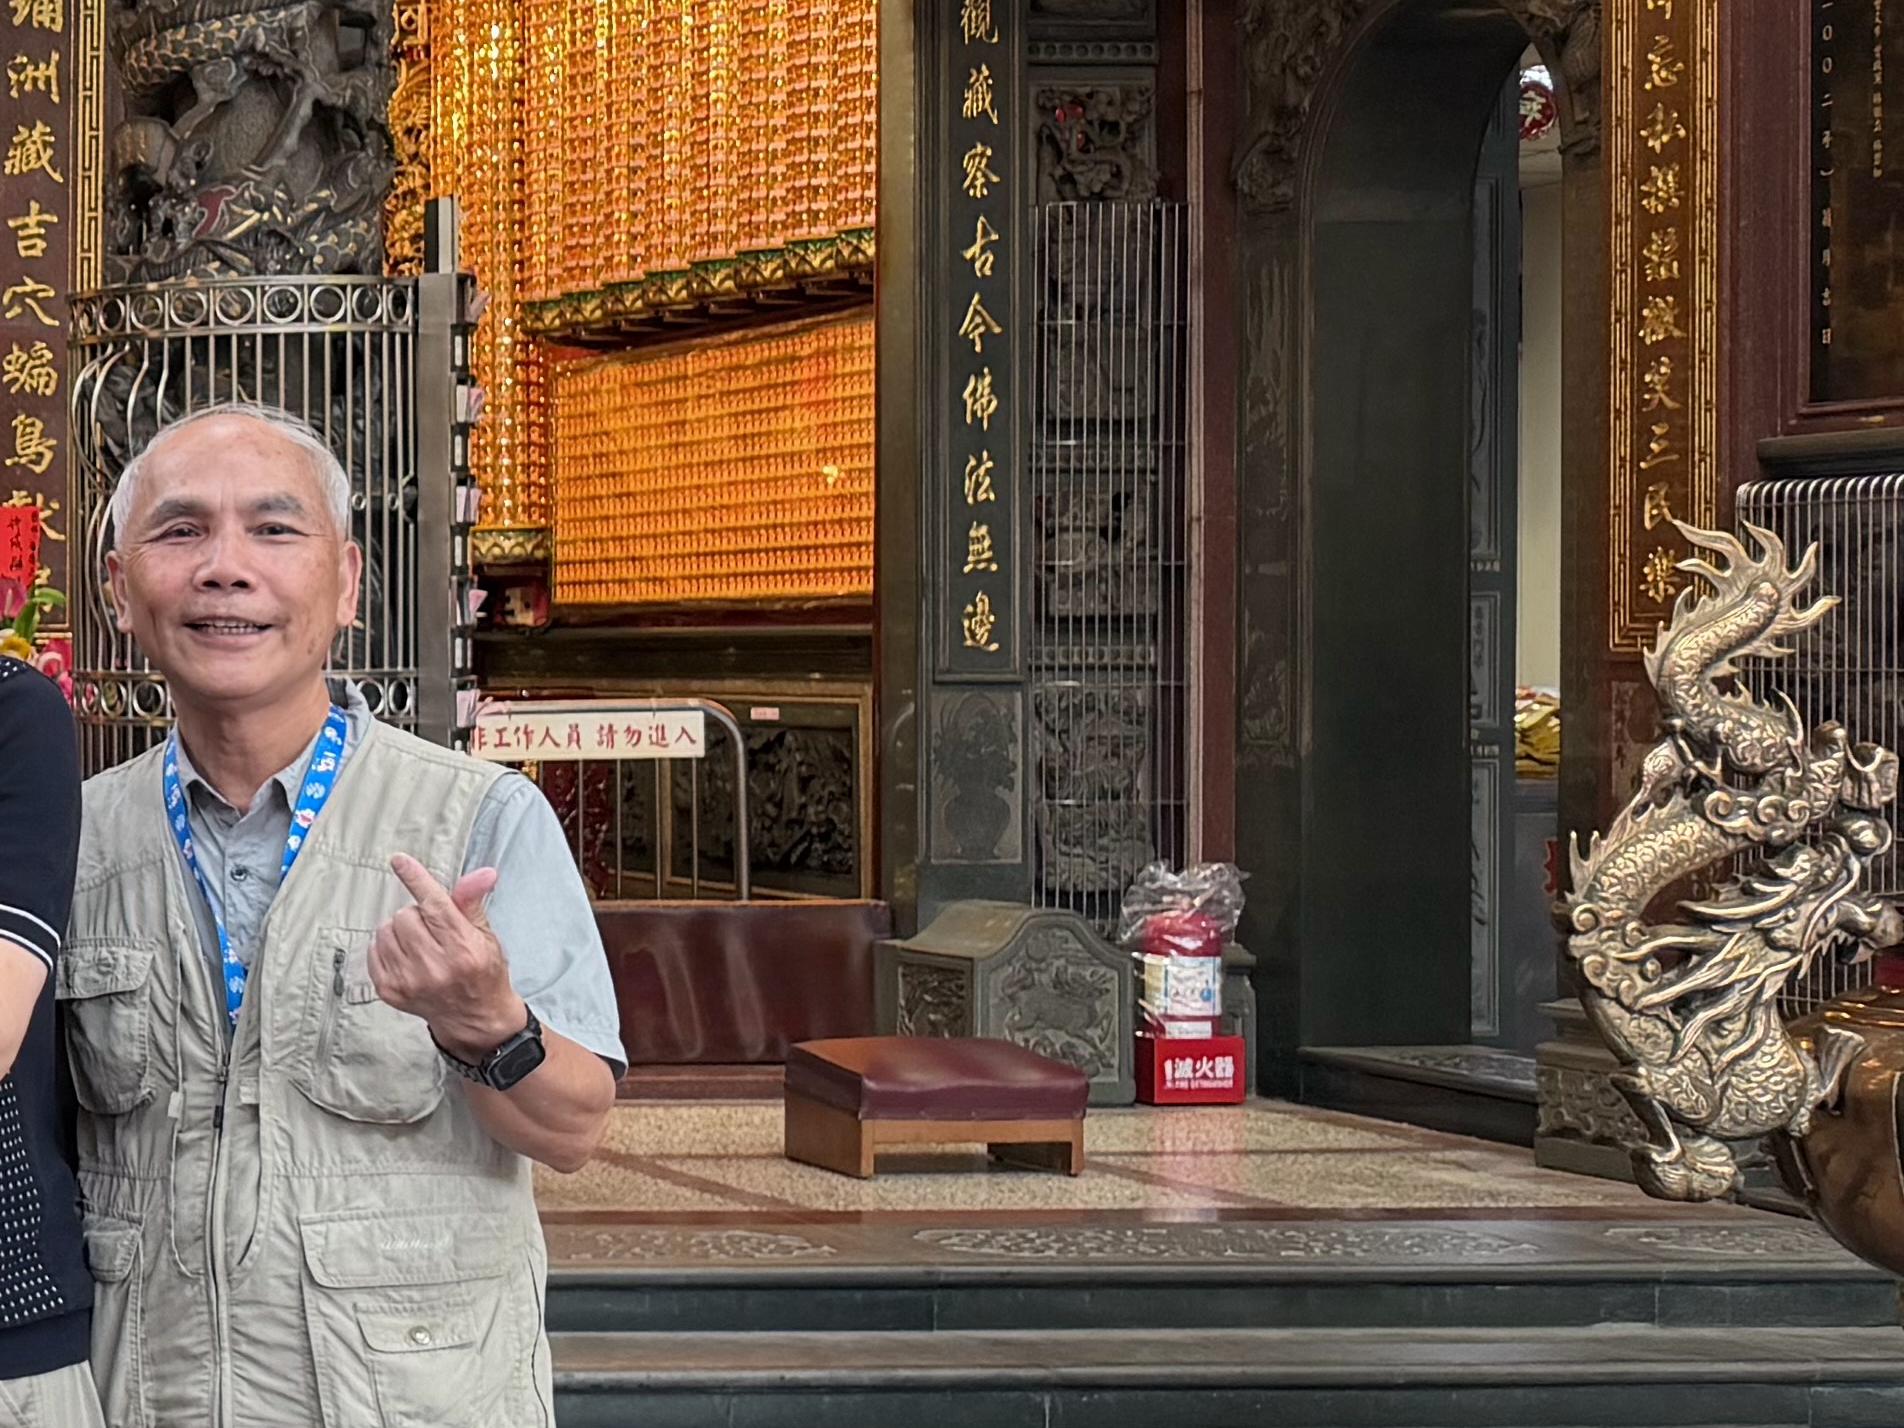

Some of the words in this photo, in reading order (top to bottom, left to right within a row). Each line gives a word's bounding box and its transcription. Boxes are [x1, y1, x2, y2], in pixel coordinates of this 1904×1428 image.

[471, 724, 583, 751] 非工作人員
[596, 723, 698, 751] 請勿進入
